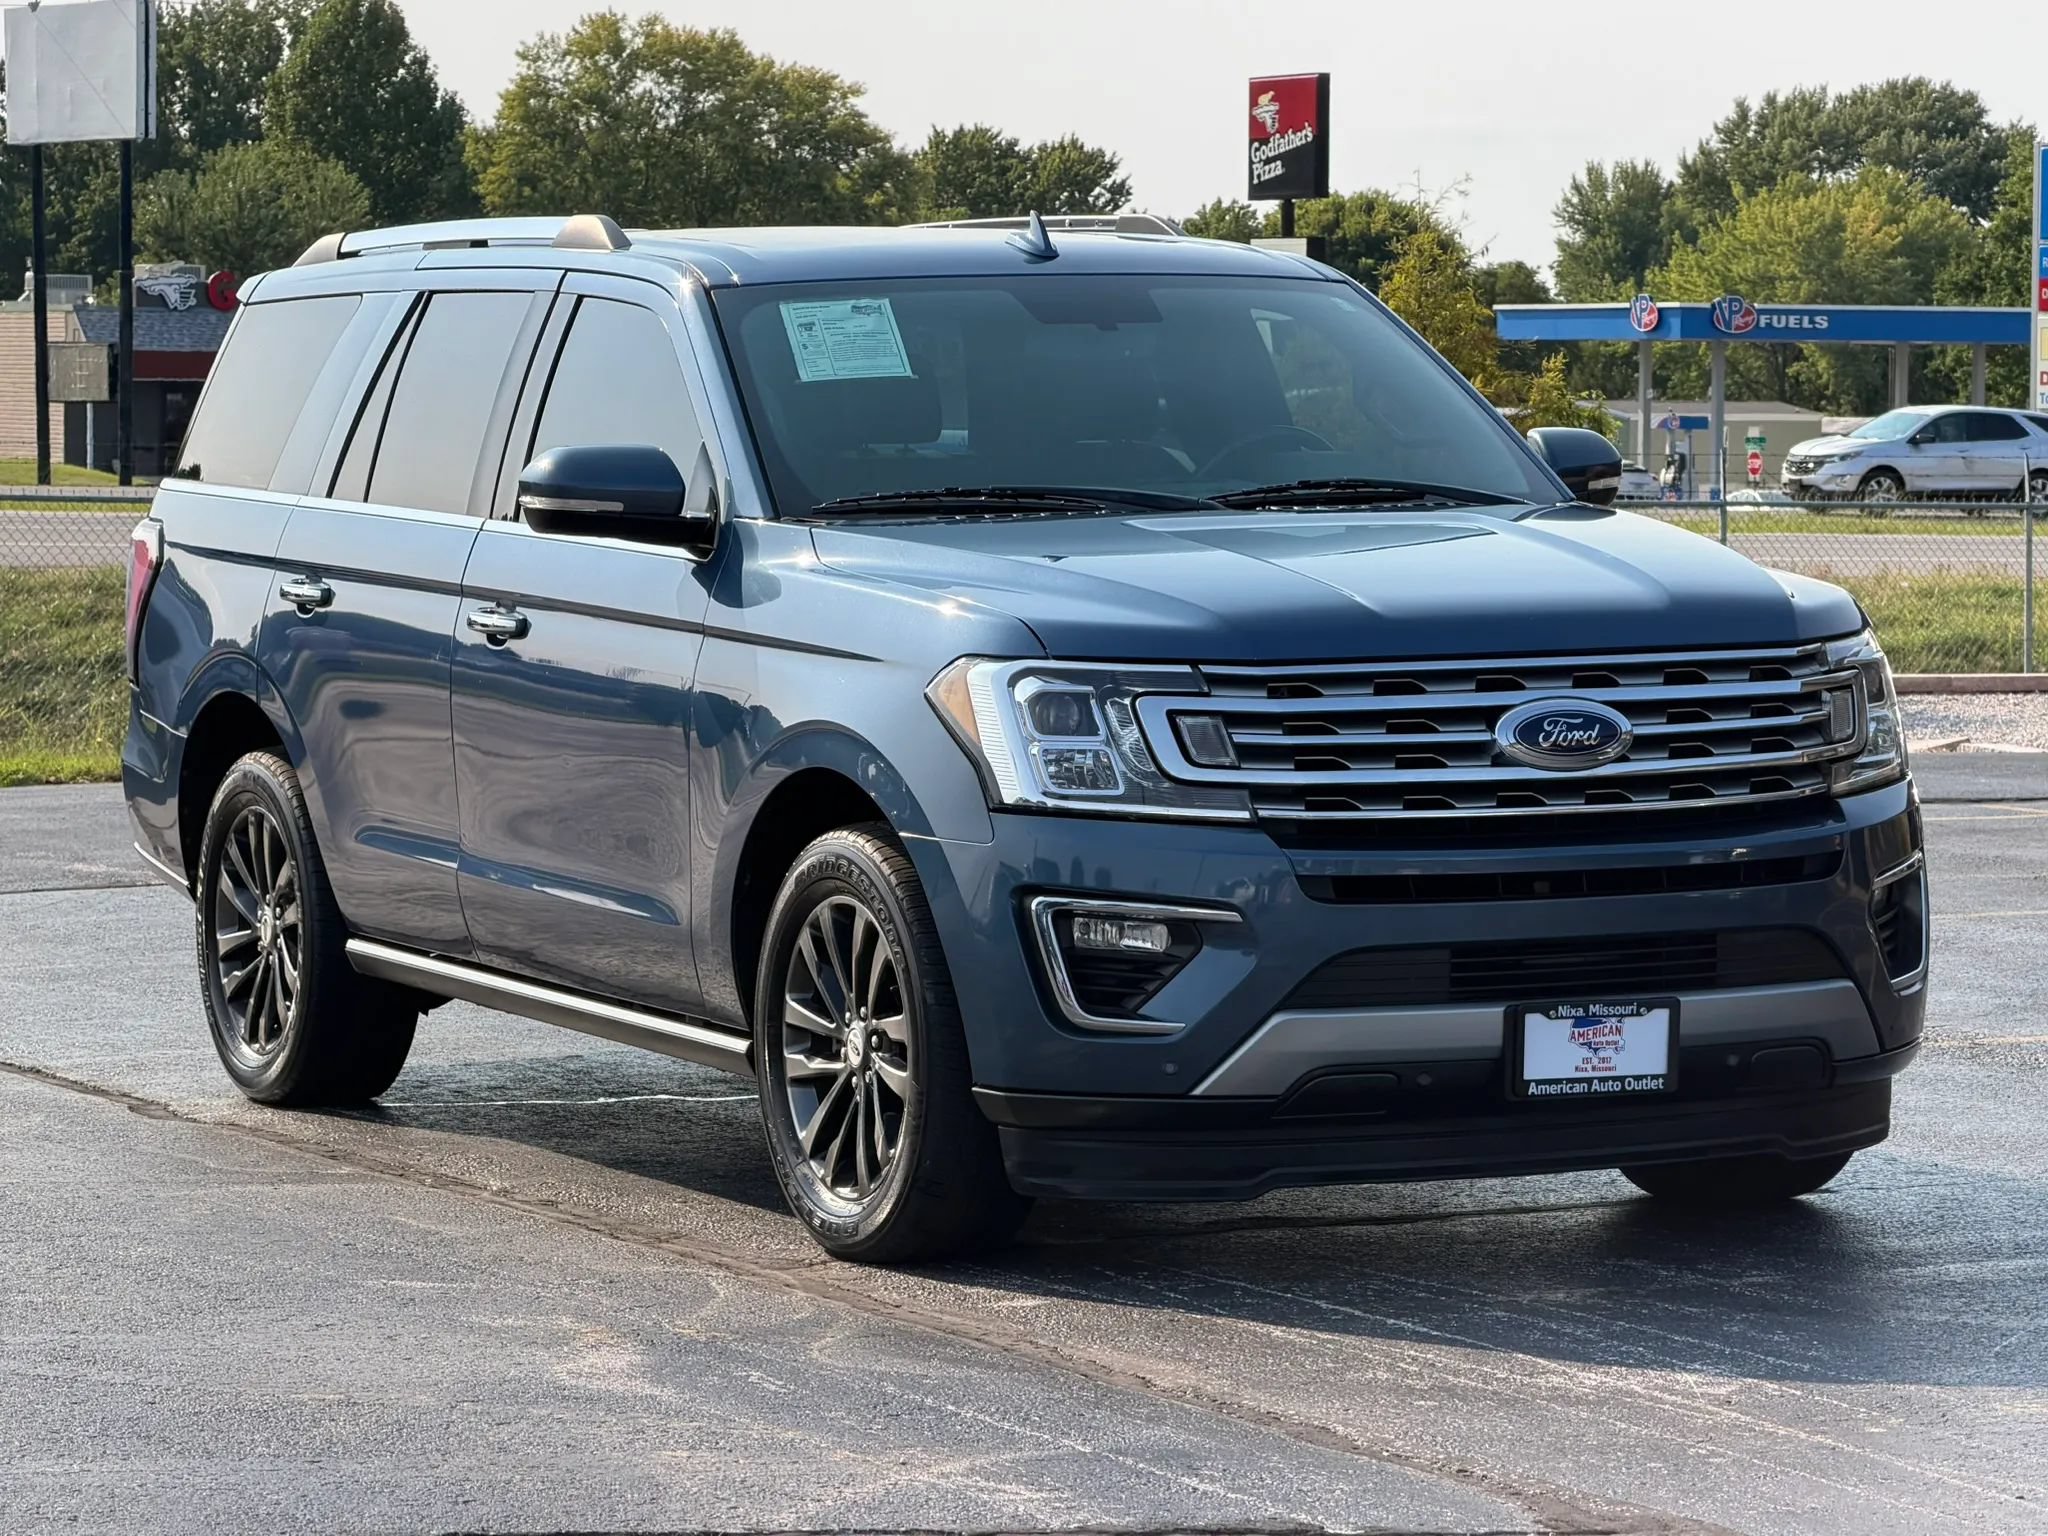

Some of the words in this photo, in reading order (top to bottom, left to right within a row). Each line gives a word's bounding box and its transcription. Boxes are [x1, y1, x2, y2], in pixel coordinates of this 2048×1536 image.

[1252, 160, 1285, 185] Pizza
[1714, 296, 1745, 332] VP
[1759, 315, 1829, 328] FUELS
[1538, 717, 1600, 747] Ford
[1589, 1002, 1637, 1016] Missouri
[1570, 1025, 1622, 1041] AMERICAN
[1528, 1081, 1588, 1095] American
[1591, 1079, 1621, 1092] Auto
[1625, 1076, 1664, 1090] Outlet
